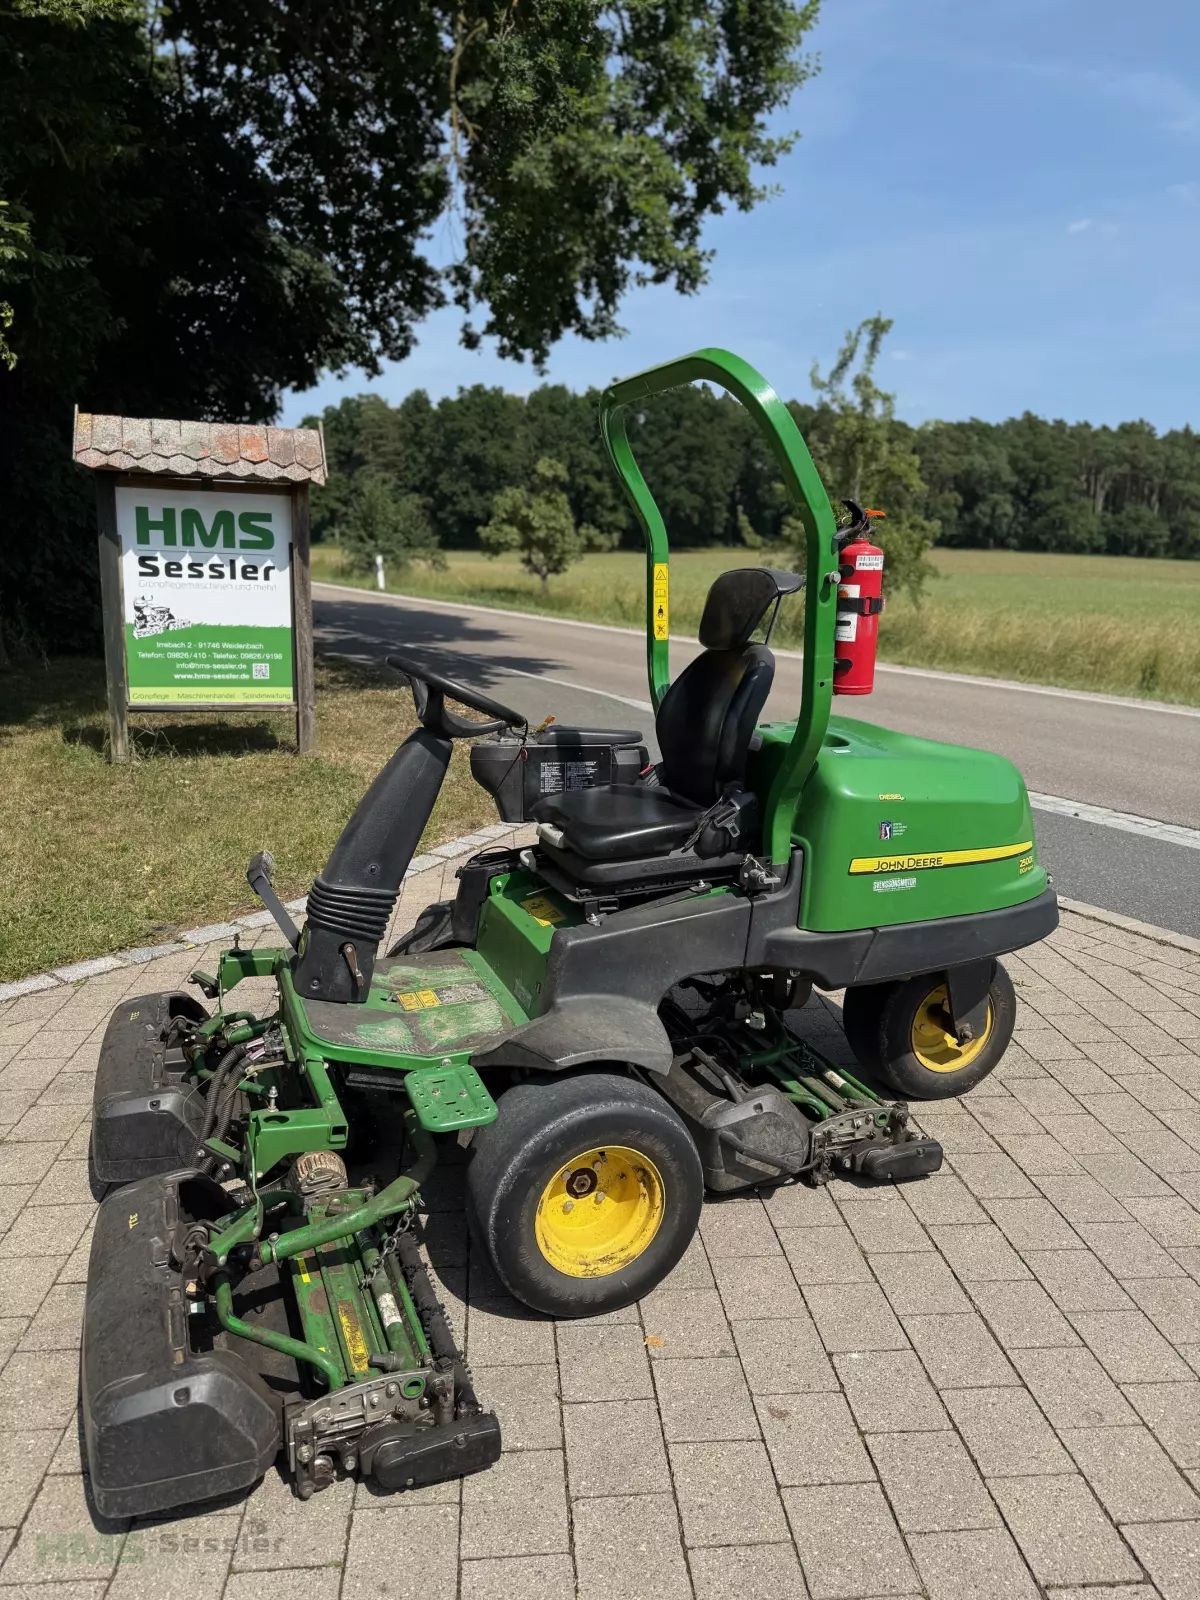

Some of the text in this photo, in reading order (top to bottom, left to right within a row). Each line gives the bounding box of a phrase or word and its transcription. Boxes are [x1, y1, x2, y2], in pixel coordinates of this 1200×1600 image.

[135, 506, 275, 550] HMS
[138, 555, 276, 581] Sessler
[235, 583, 252, 591] und
[873, 856, 944, 872] JOHN DEERE
